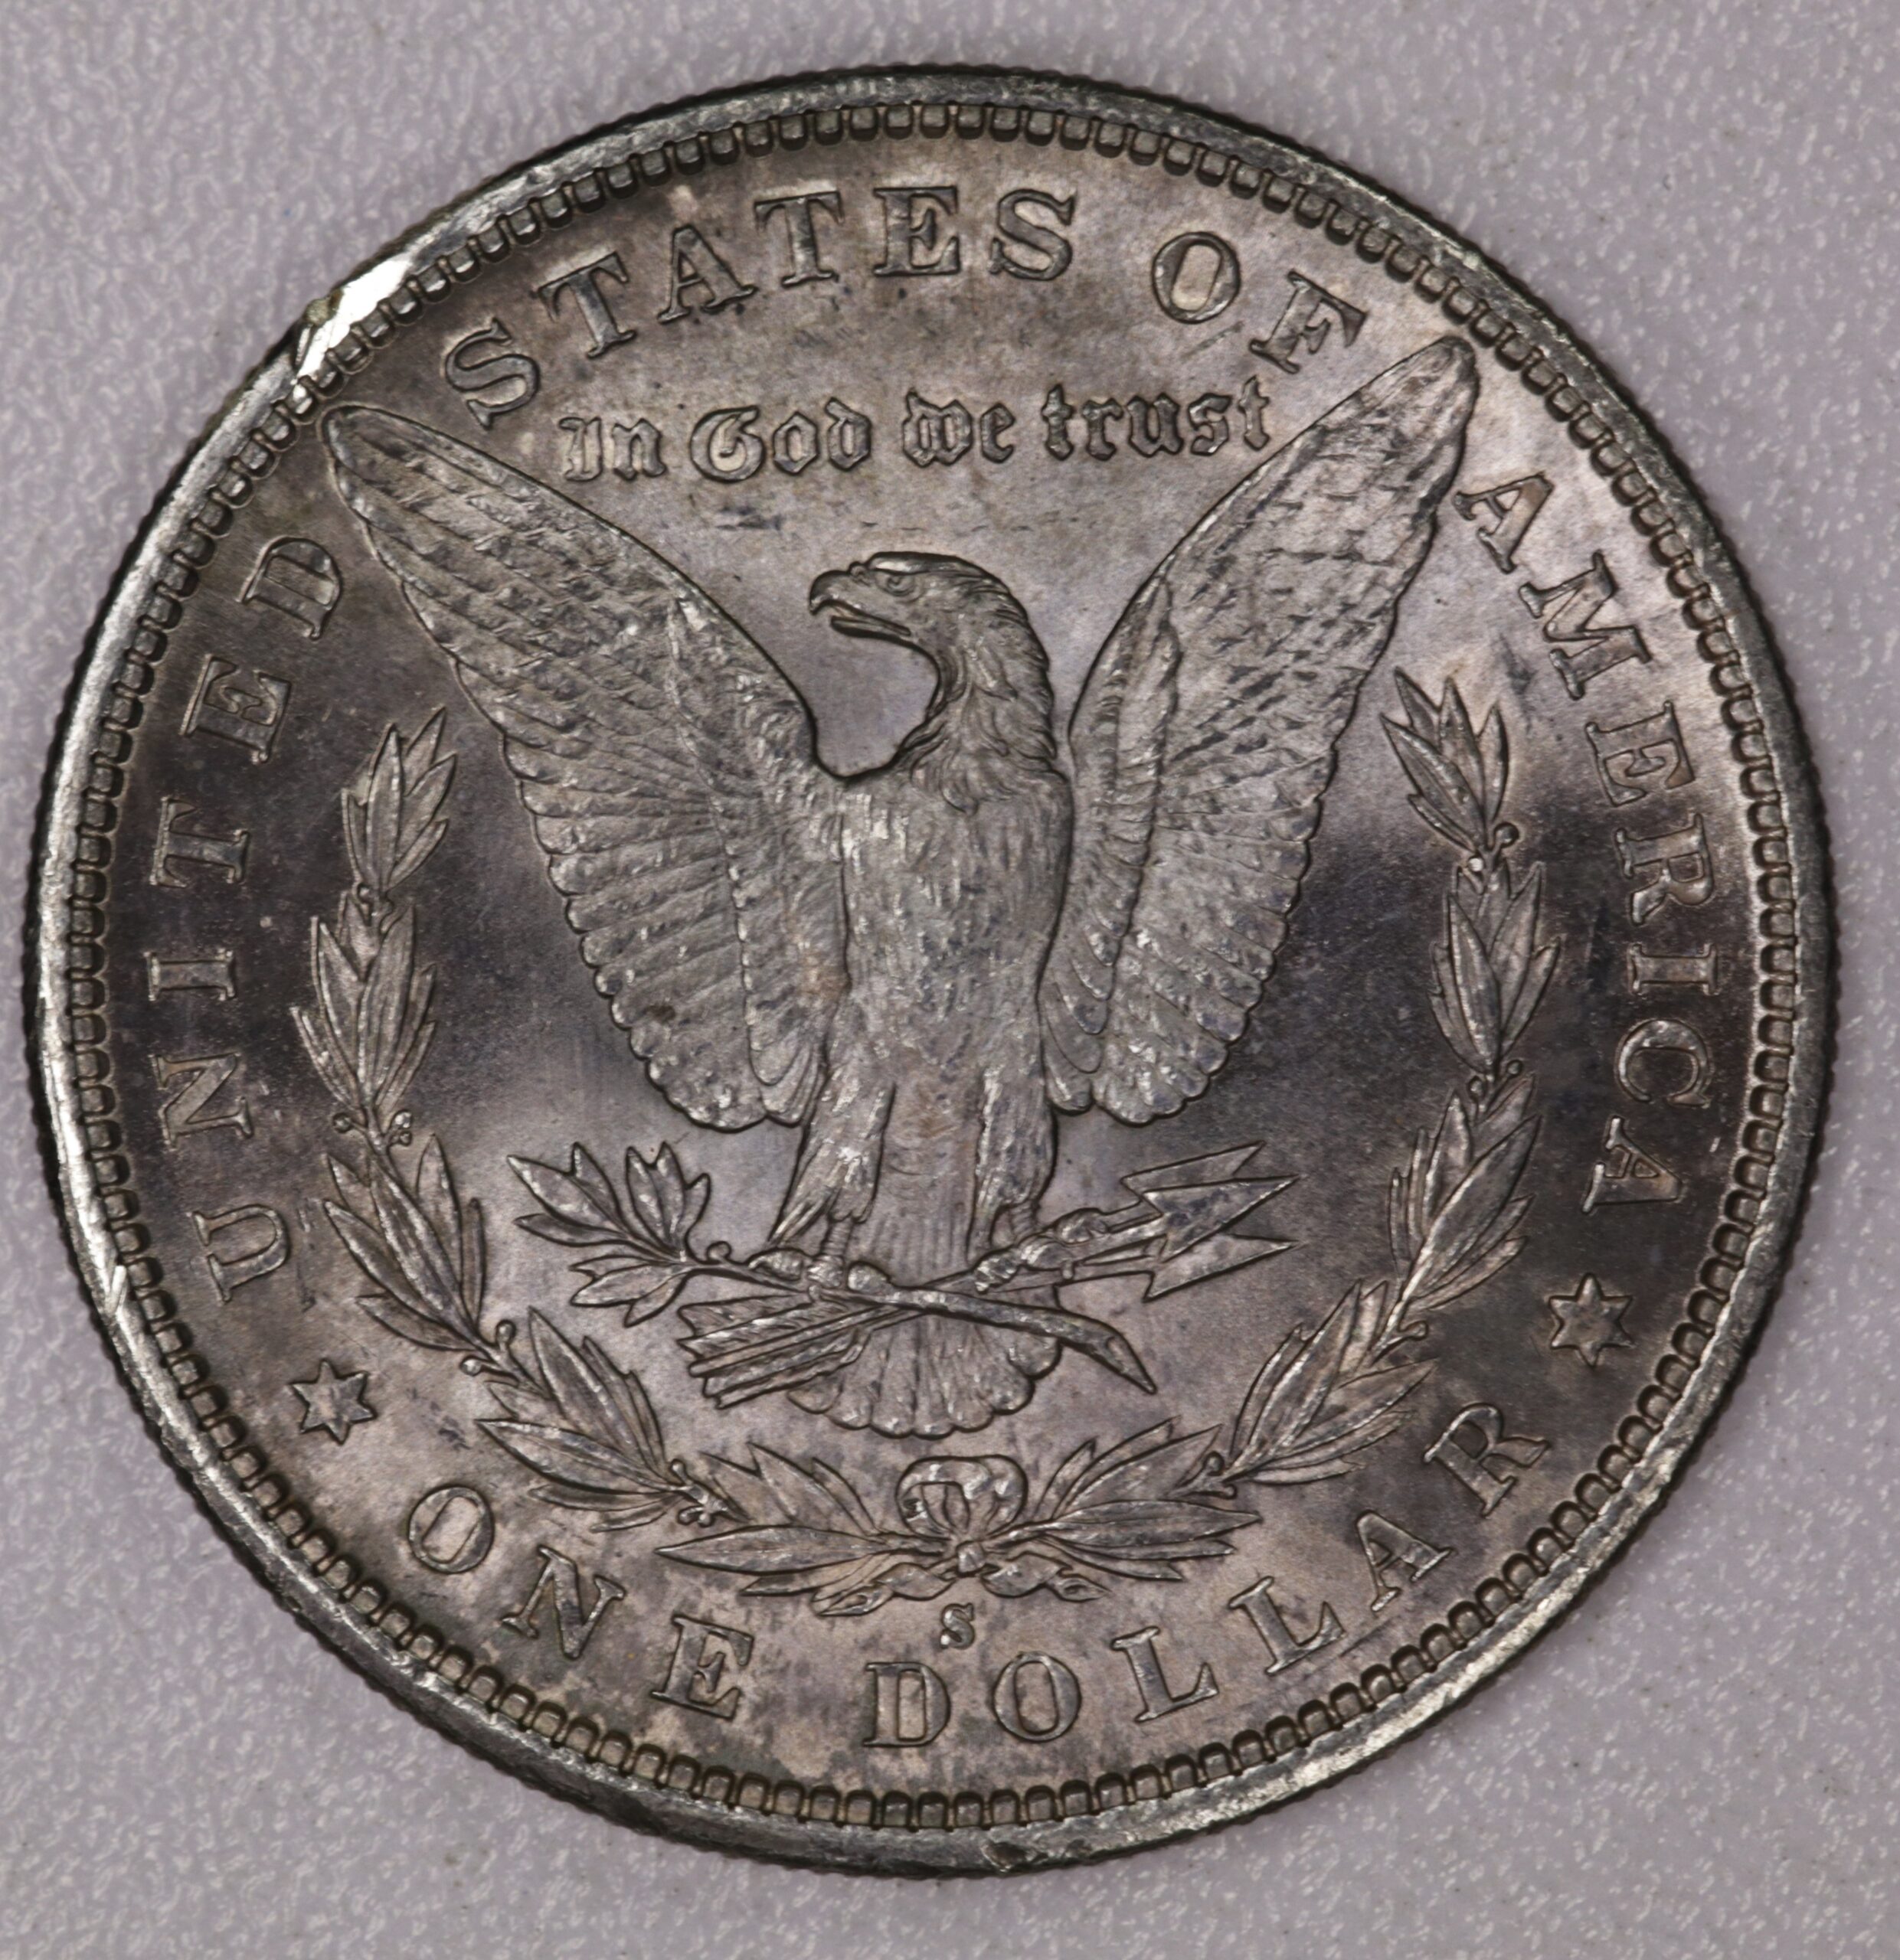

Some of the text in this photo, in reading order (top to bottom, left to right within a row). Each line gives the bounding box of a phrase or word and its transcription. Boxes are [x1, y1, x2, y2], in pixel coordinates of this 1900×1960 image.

[561, 377, 1271, 482] In God we trust
[147, 189, 1722, 1302] UNITED STATES OF AMERICA
[406, 1404, 1548, 1746] ONE DOLLAR
[940, 1601, 974, 1646] S
